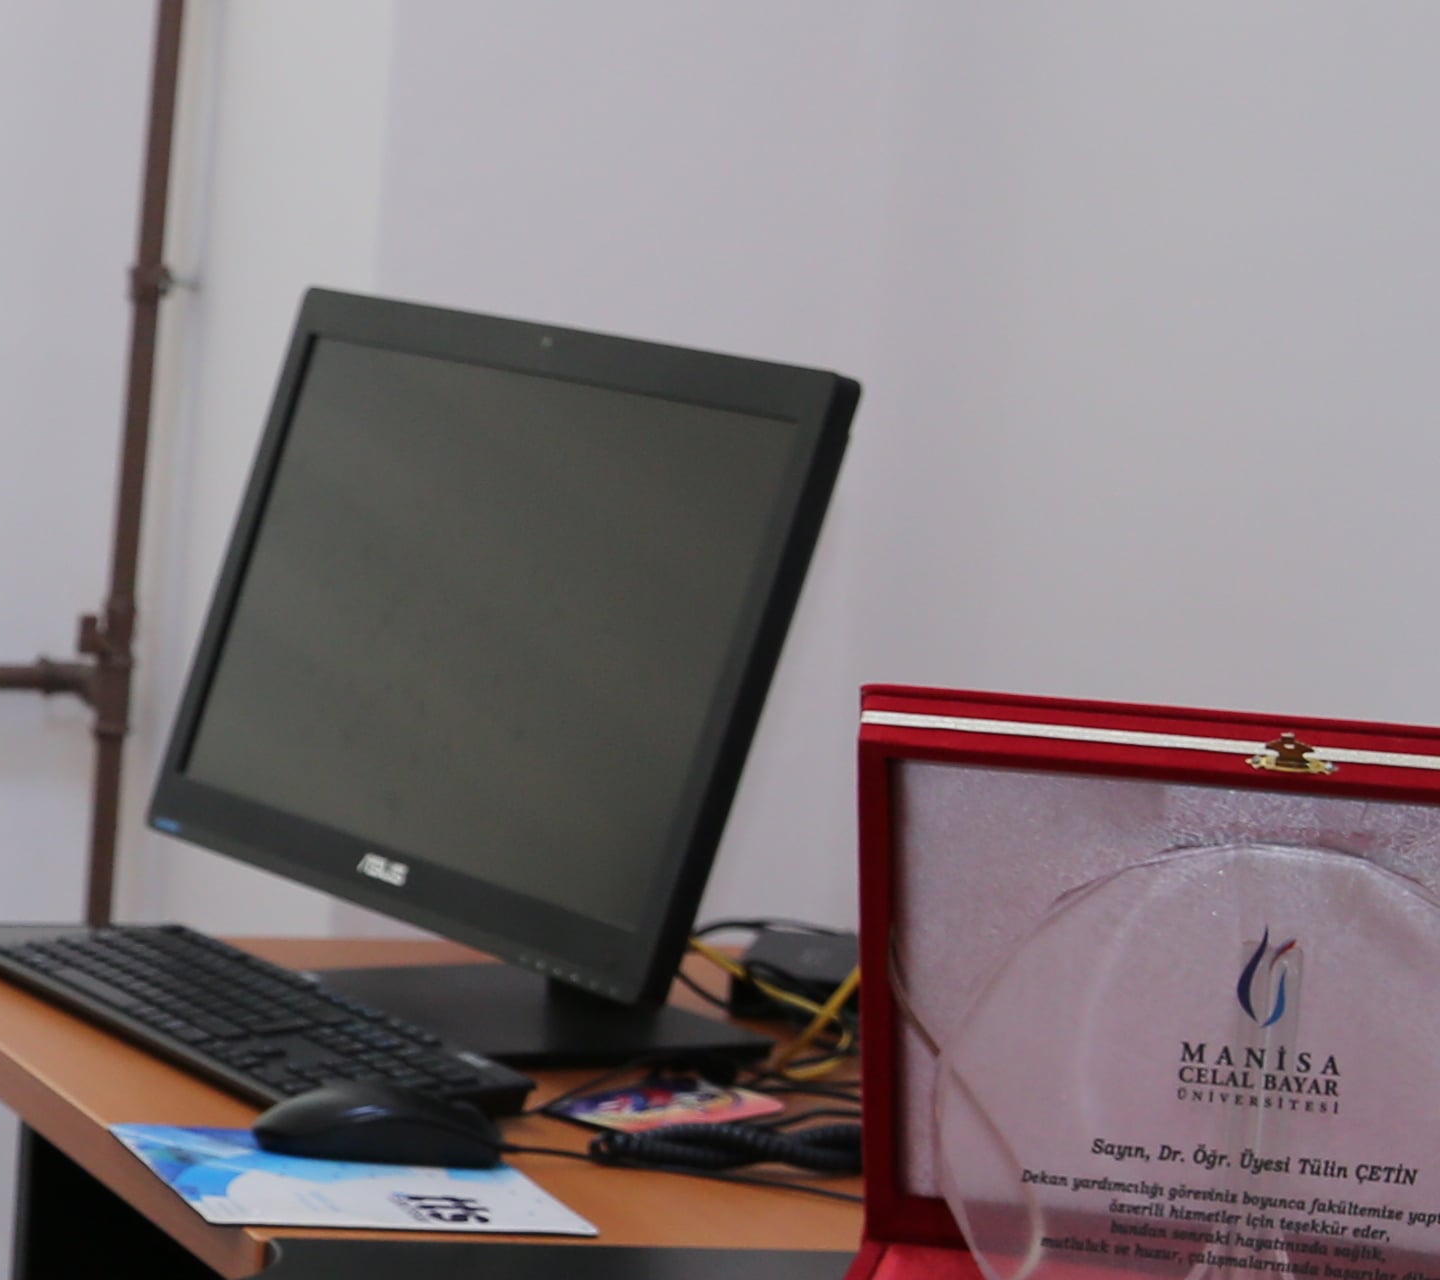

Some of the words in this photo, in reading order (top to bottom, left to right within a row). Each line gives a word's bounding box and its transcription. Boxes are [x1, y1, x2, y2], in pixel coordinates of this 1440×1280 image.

[1180, 1041, 1341, 1076] MANİSA
[1178, 1066, 1255, 1089] CELAL
[1264, 1073, 1339, 1097] BAYAR
[1177, 1087, 1339, 1114] ÜNİVERSİTESİ
[1091, 1138, 1151, 1162] Sayın,
[1158, 1144, 1185, 1162] Dr.
[1193, 1144, 1231, 1170] Öğr.
[1240, 1149, 1291, 1174] Üyesi
[1298, 1158, 1348, 1179] Tülin
[1355, 1164, 1419, 1185] ÇETİN
[1021, 1169, 1068, 1187] Dekan
[1072, 1177, 1164, 1199] yardımcılığı
[1168, 1184, 1238, 1204] göreviniz
[1243, 1191, 1306, 1210] boyunca
[1308, 1198, 1403, 1220] fakültemize
[1109, 1199, 1165, 1216] özverili
[1169, 1206, 1241, 1226] hizmetler
[1246, 1213, 1274, 1230] için
[1280, 1219, 1348, 1237] teşekkür
[1352, 1225, 1390, 1242] eder,
[1235, 1234, 1328, 1256] hayatınızda
